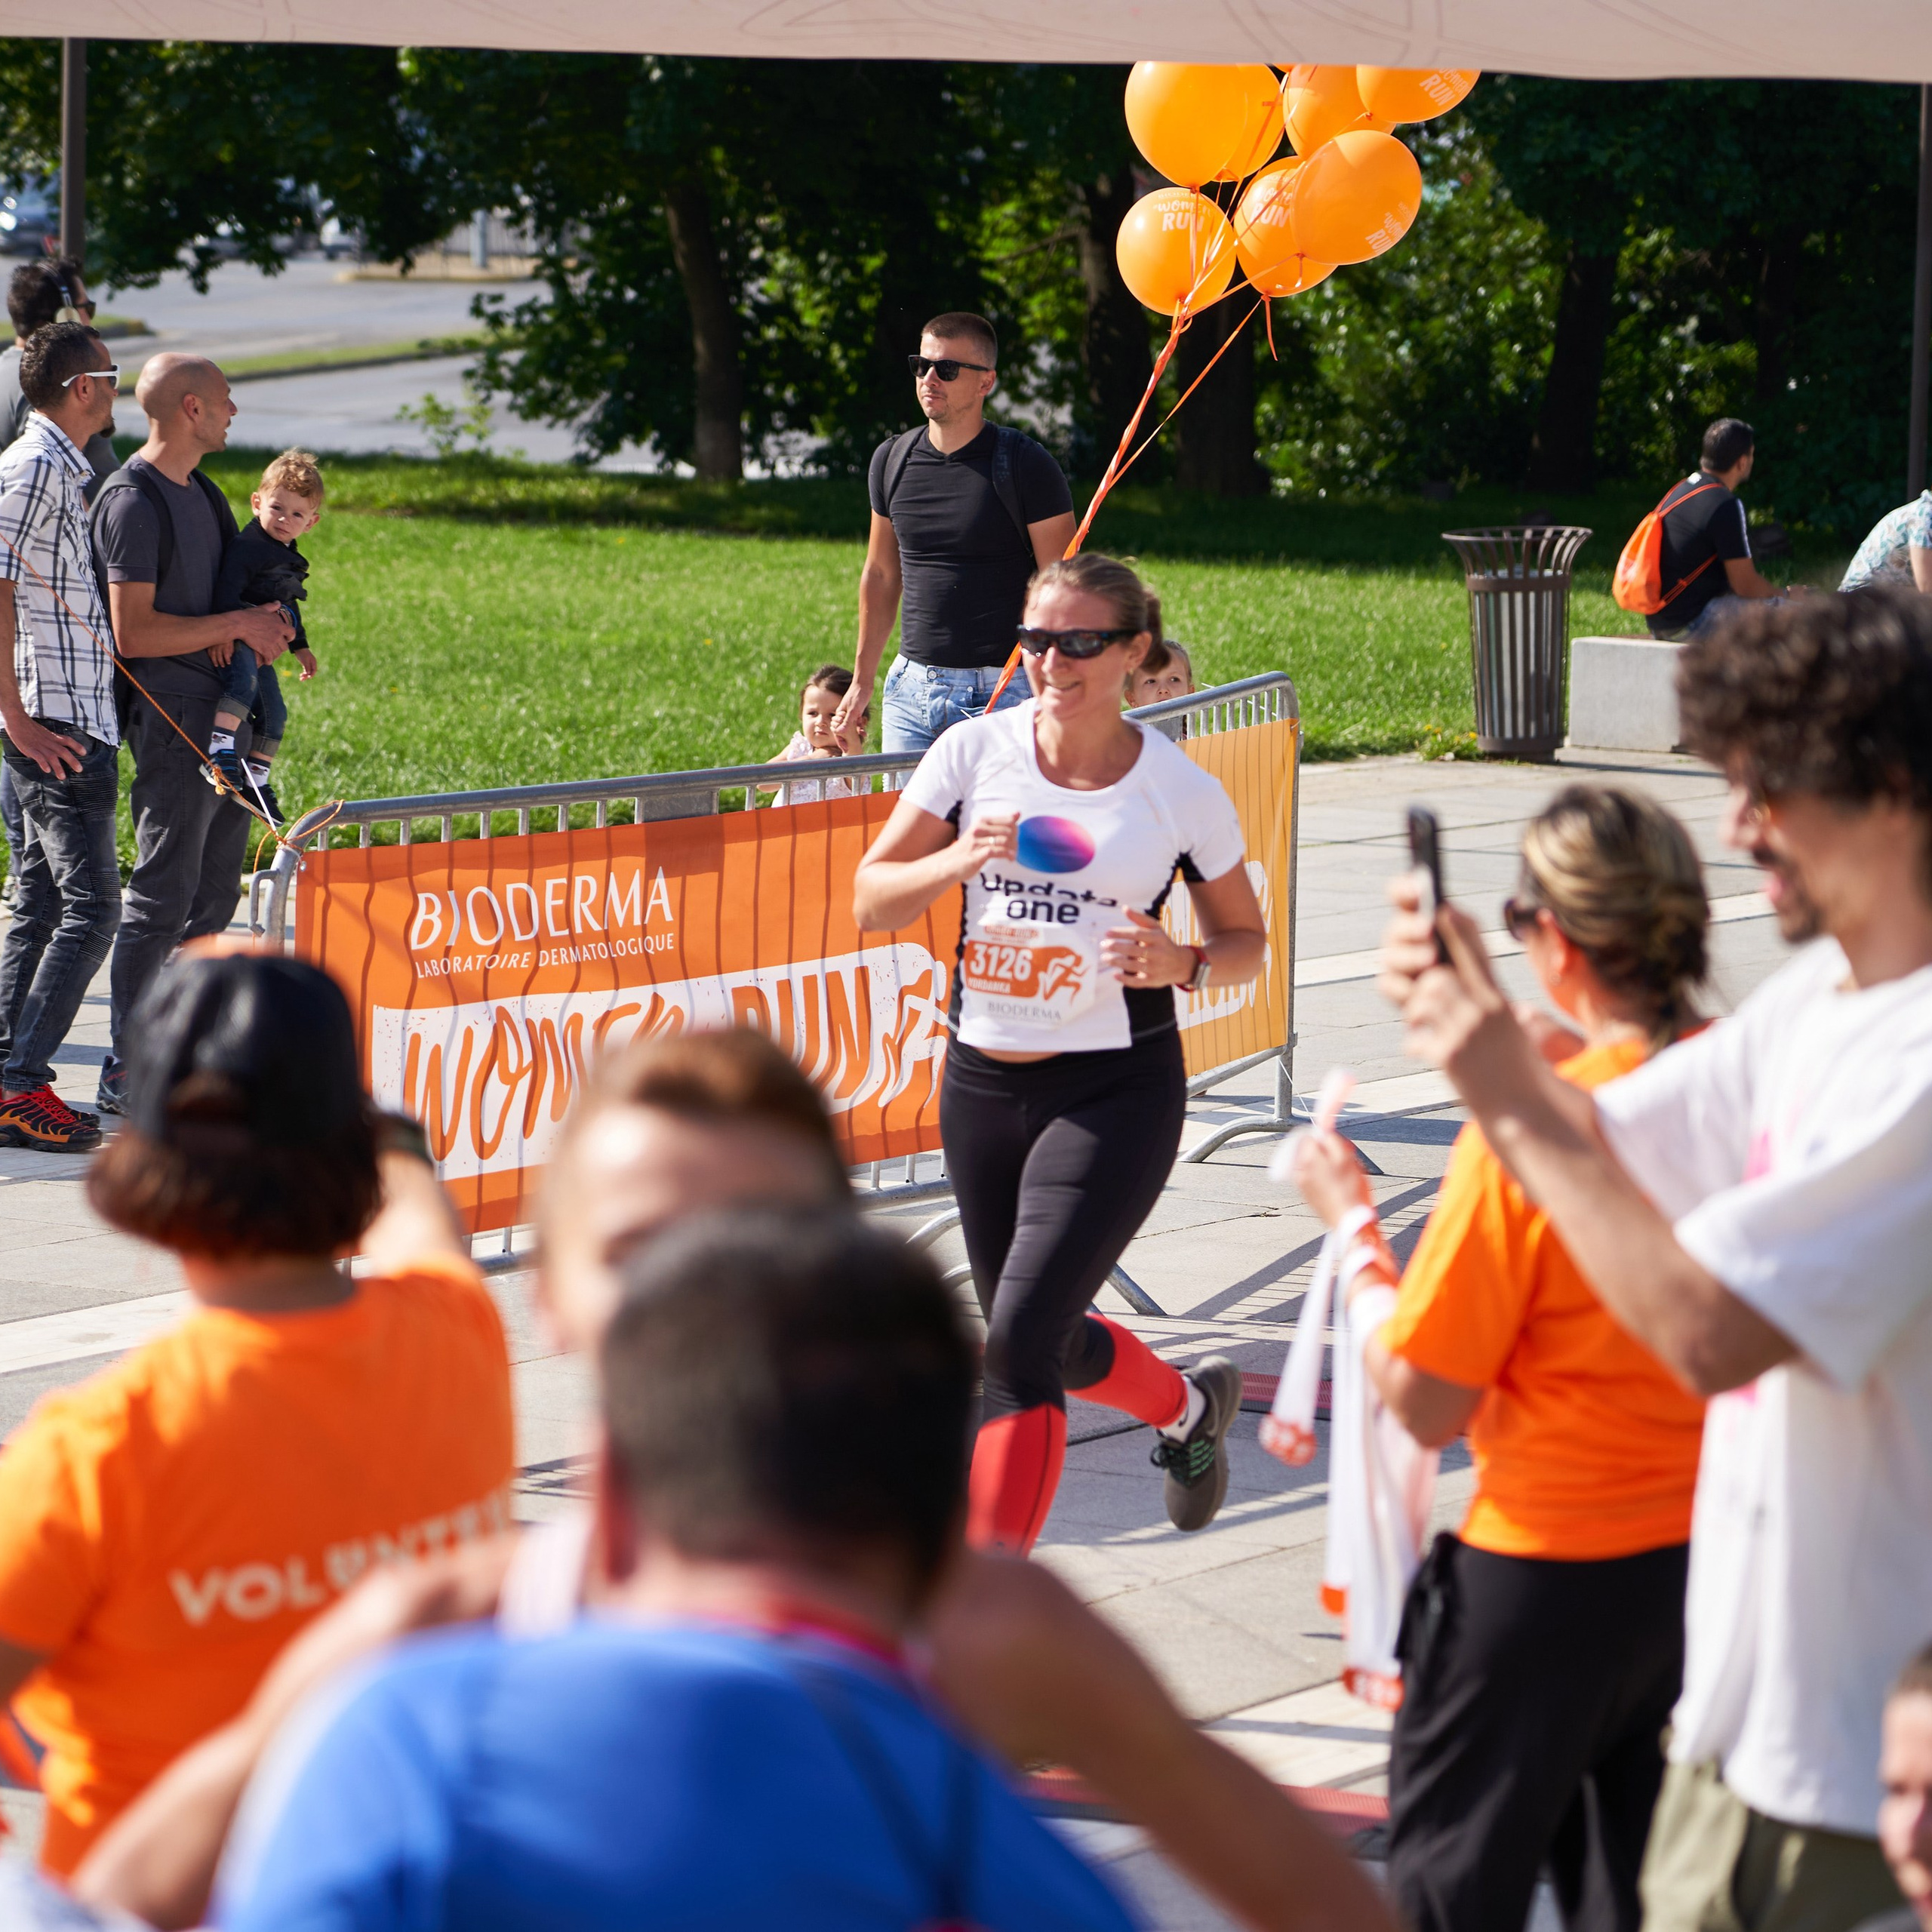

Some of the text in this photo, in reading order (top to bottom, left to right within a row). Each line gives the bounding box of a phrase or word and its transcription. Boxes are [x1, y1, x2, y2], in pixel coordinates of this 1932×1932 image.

[1419, 73, 1456, 106] RUN
[1162, 212, 1204, 232] RUN
[1249, 202, 1292, 228] RUN
[411, 866, 674, 950] BIODERMA
[1007, 900, 1080, 924] one
[415, 933, 675, 979] LABORATOIRE DERMATOLOGIQUE
[970, 943, 1033, 981] 3126
[988, 1001, 1062, 1020] BIODERMA
